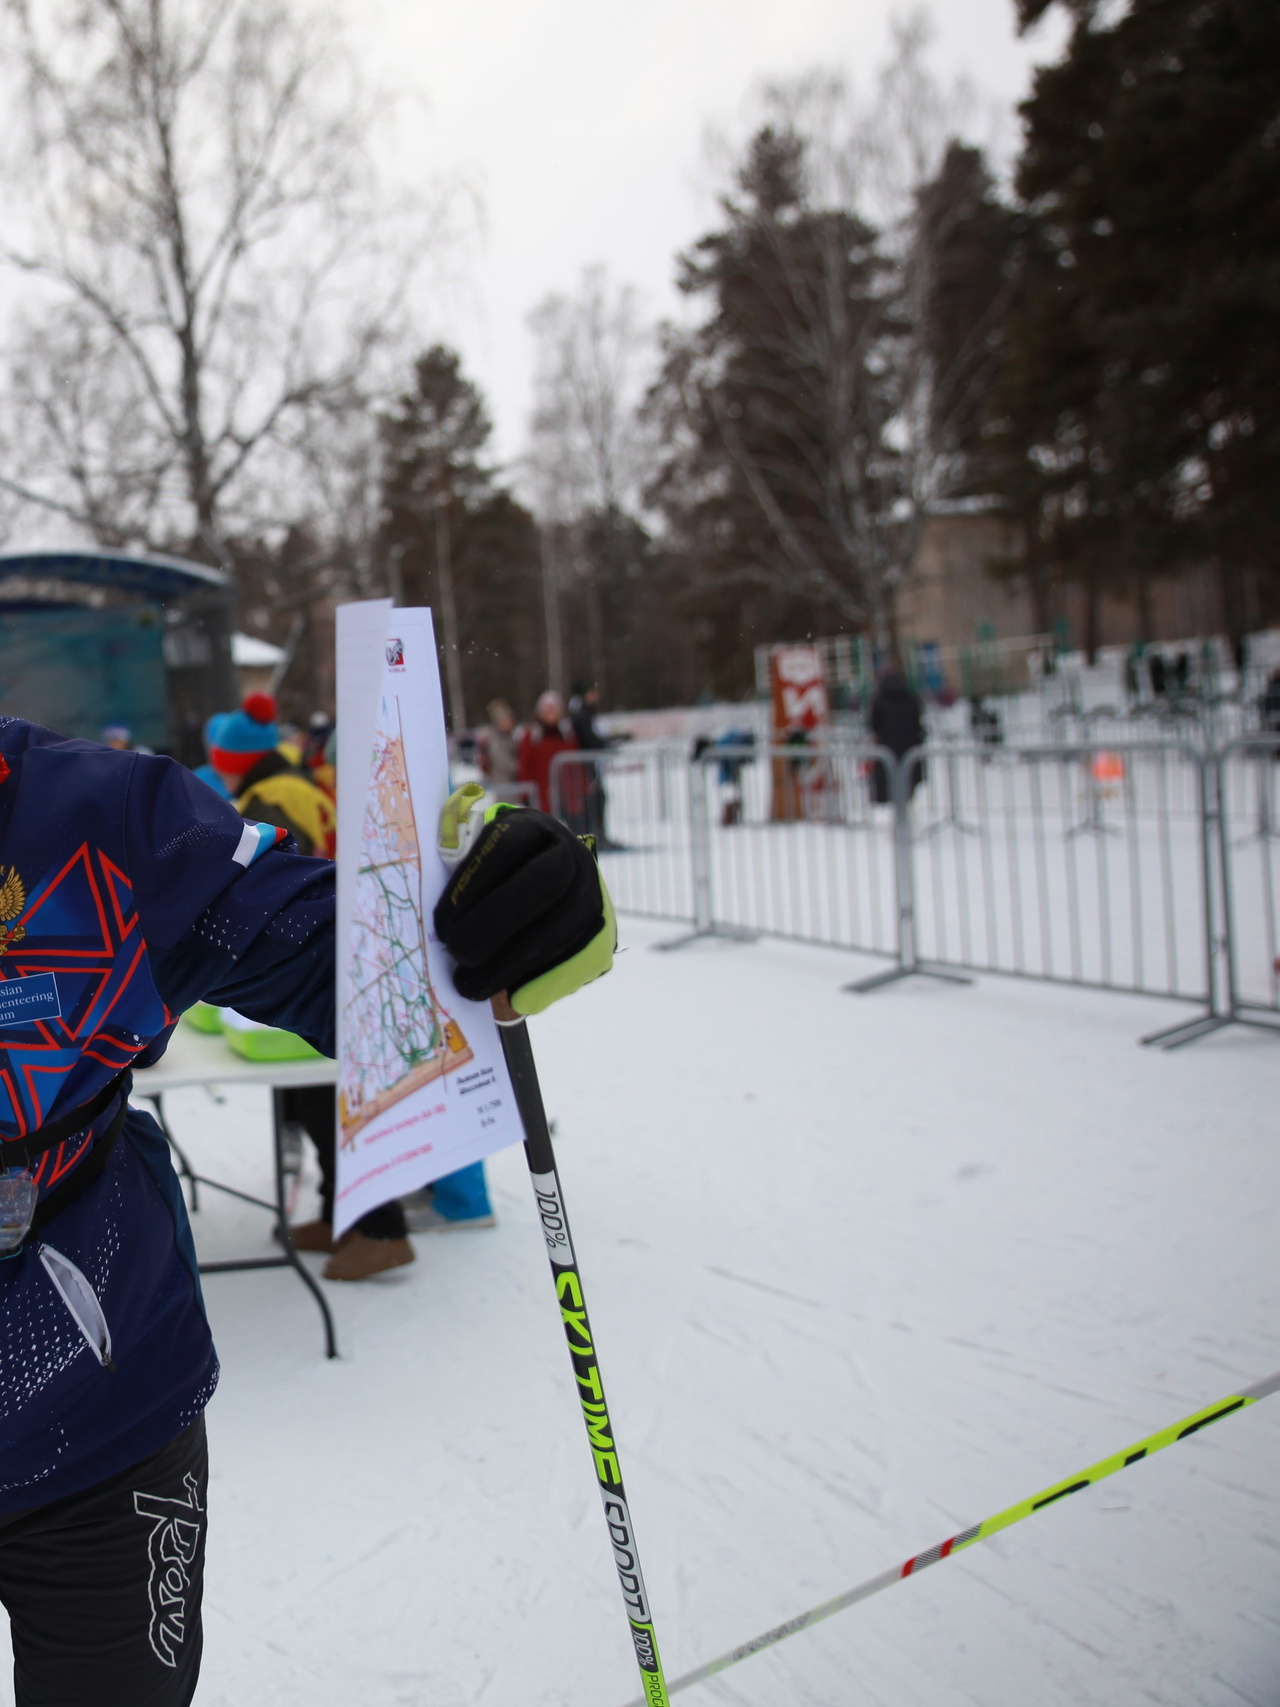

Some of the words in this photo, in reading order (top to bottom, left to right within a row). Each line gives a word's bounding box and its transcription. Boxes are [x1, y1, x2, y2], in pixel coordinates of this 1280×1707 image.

[535, 1188, 567, 1248] 100%
[632, 1629, 655, 1666] 100%
[646, 1673, 665, 1707] PROC
